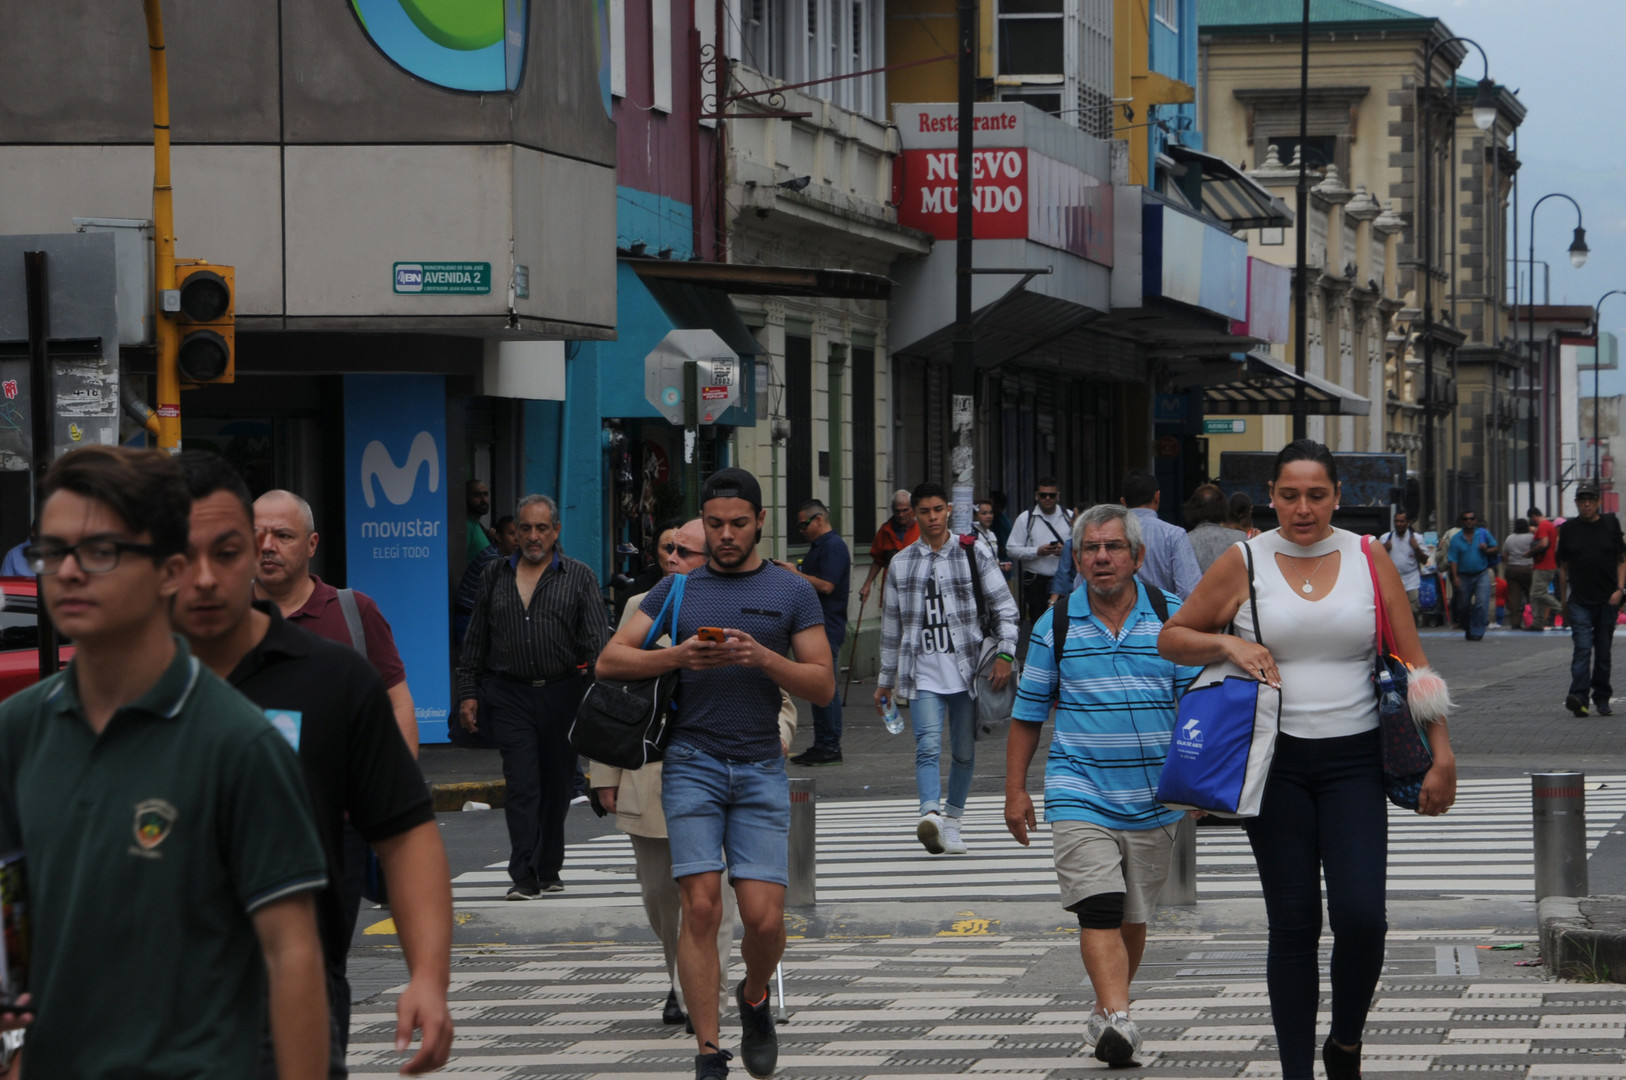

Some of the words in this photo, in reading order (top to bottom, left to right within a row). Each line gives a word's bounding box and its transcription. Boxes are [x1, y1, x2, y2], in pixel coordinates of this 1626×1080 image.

[919, 112, 1017, 132] Restarante
[424, 272, 471, 283] AVENIDA
[473, 272, 481, 283] 2
[361, 519, 440, 538] movistar
[373, 544, 400, 558] ELEGÍ
[402, 546, 429, 558] TODO
